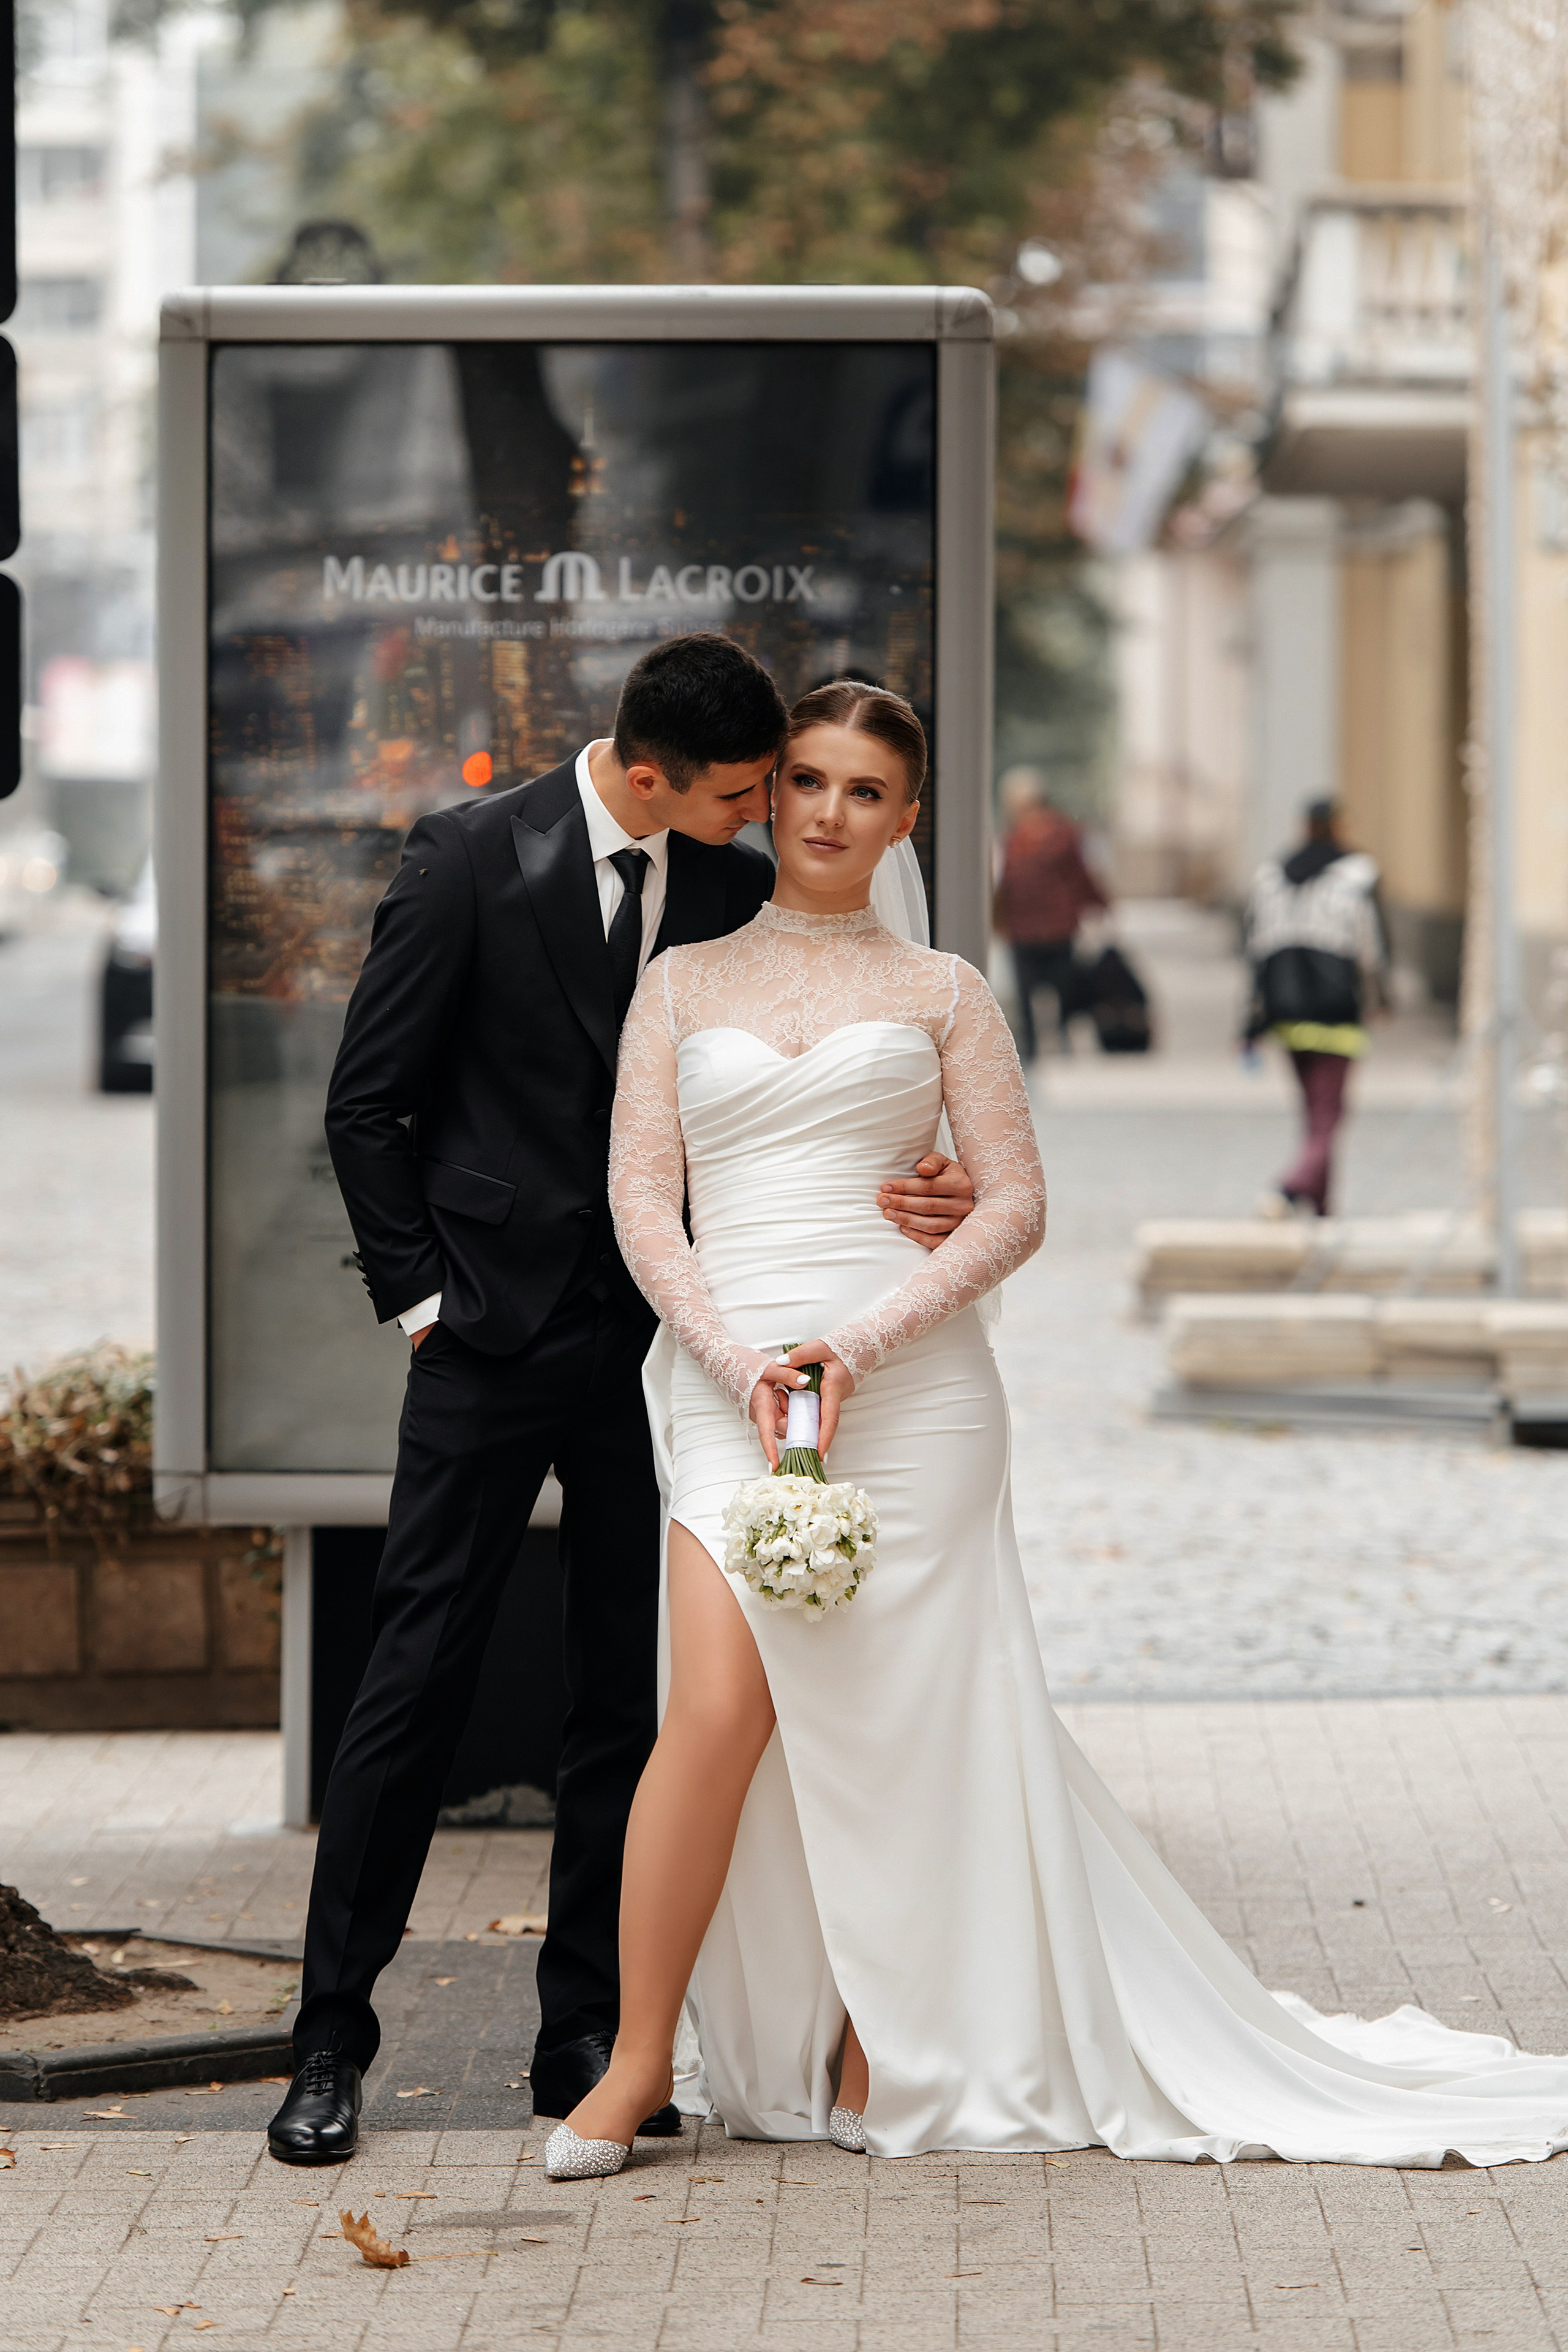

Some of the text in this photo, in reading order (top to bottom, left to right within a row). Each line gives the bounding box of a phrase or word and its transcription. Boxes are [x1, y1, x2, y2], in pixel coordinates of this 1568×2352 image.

[323, 555, 524, 603] MAURICE
[618, 556, 816, 603] LACROIX
[414, 616, 546, 640] Manufacture
